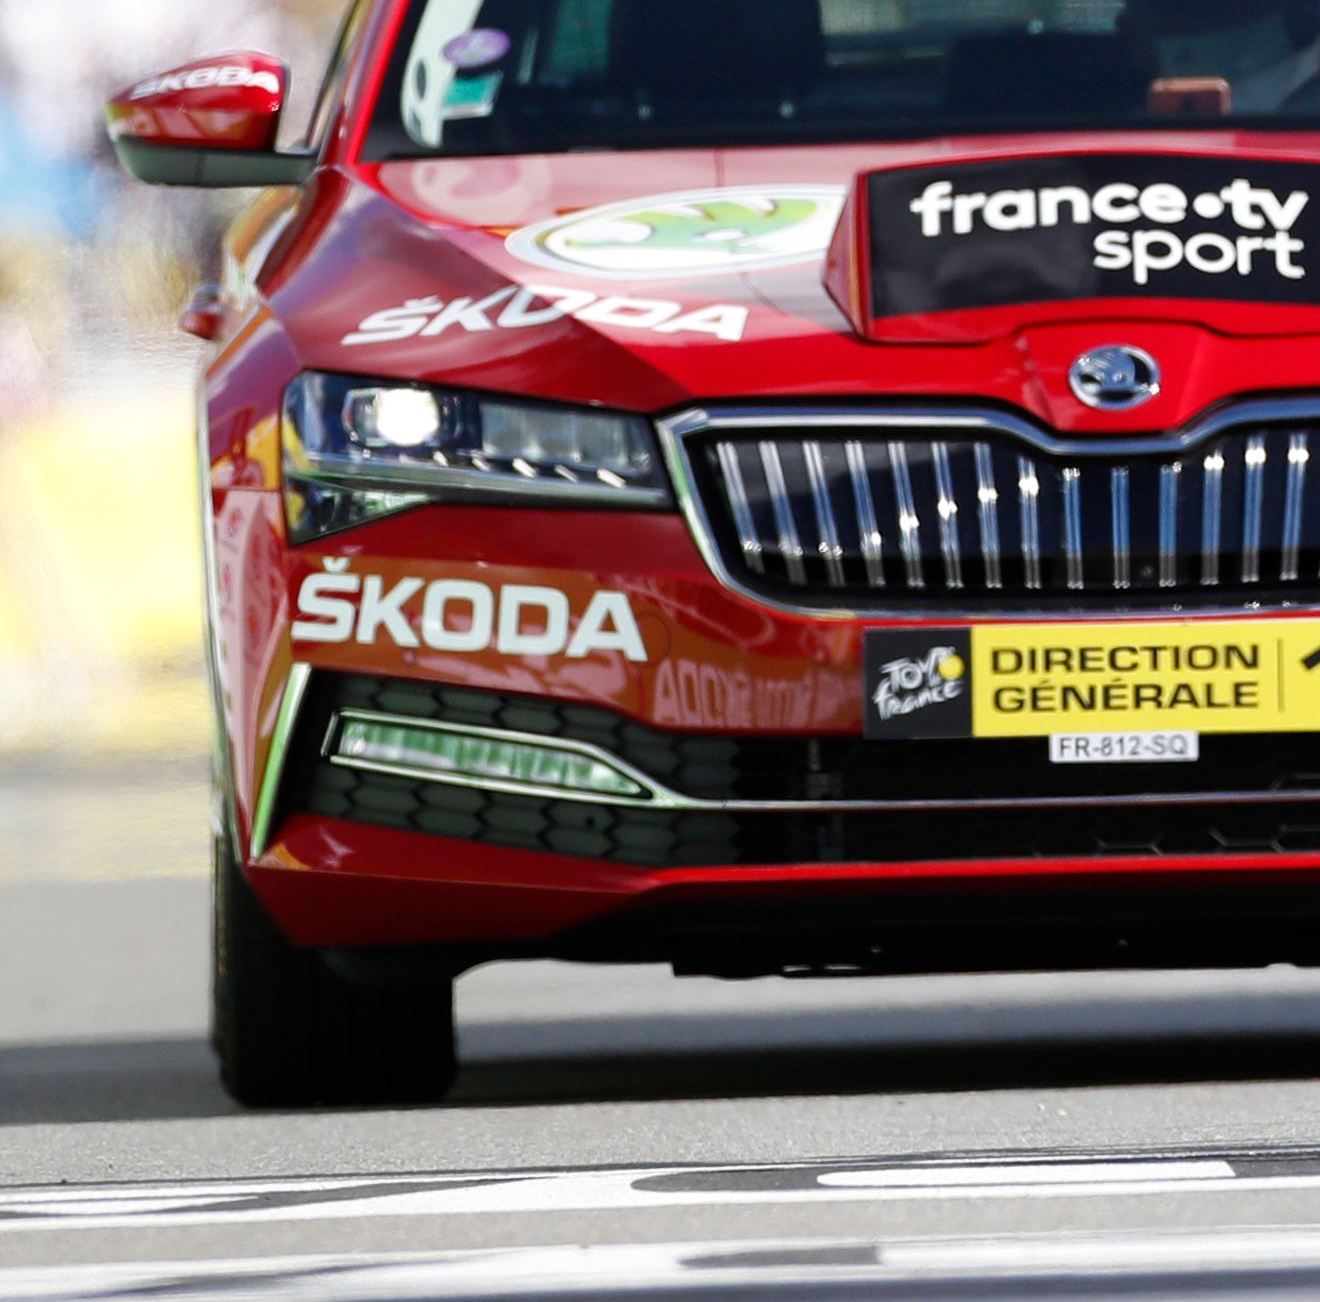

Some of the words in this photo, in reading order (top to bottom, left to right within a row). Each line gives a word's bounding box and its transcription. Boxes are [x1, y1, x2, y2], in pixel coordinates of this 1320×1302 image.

[1093, 229, 1306, 285] sport
[340, 282, 750, 346] ŠKODA
[292, 557, 648, 661] ŠKODA
[991, 644, 1259, 675] DIRECTION
[993, 678, 1259, 714] GÉNÉRALE
[1059, 735, 1189, 759] FR-812-SQ
